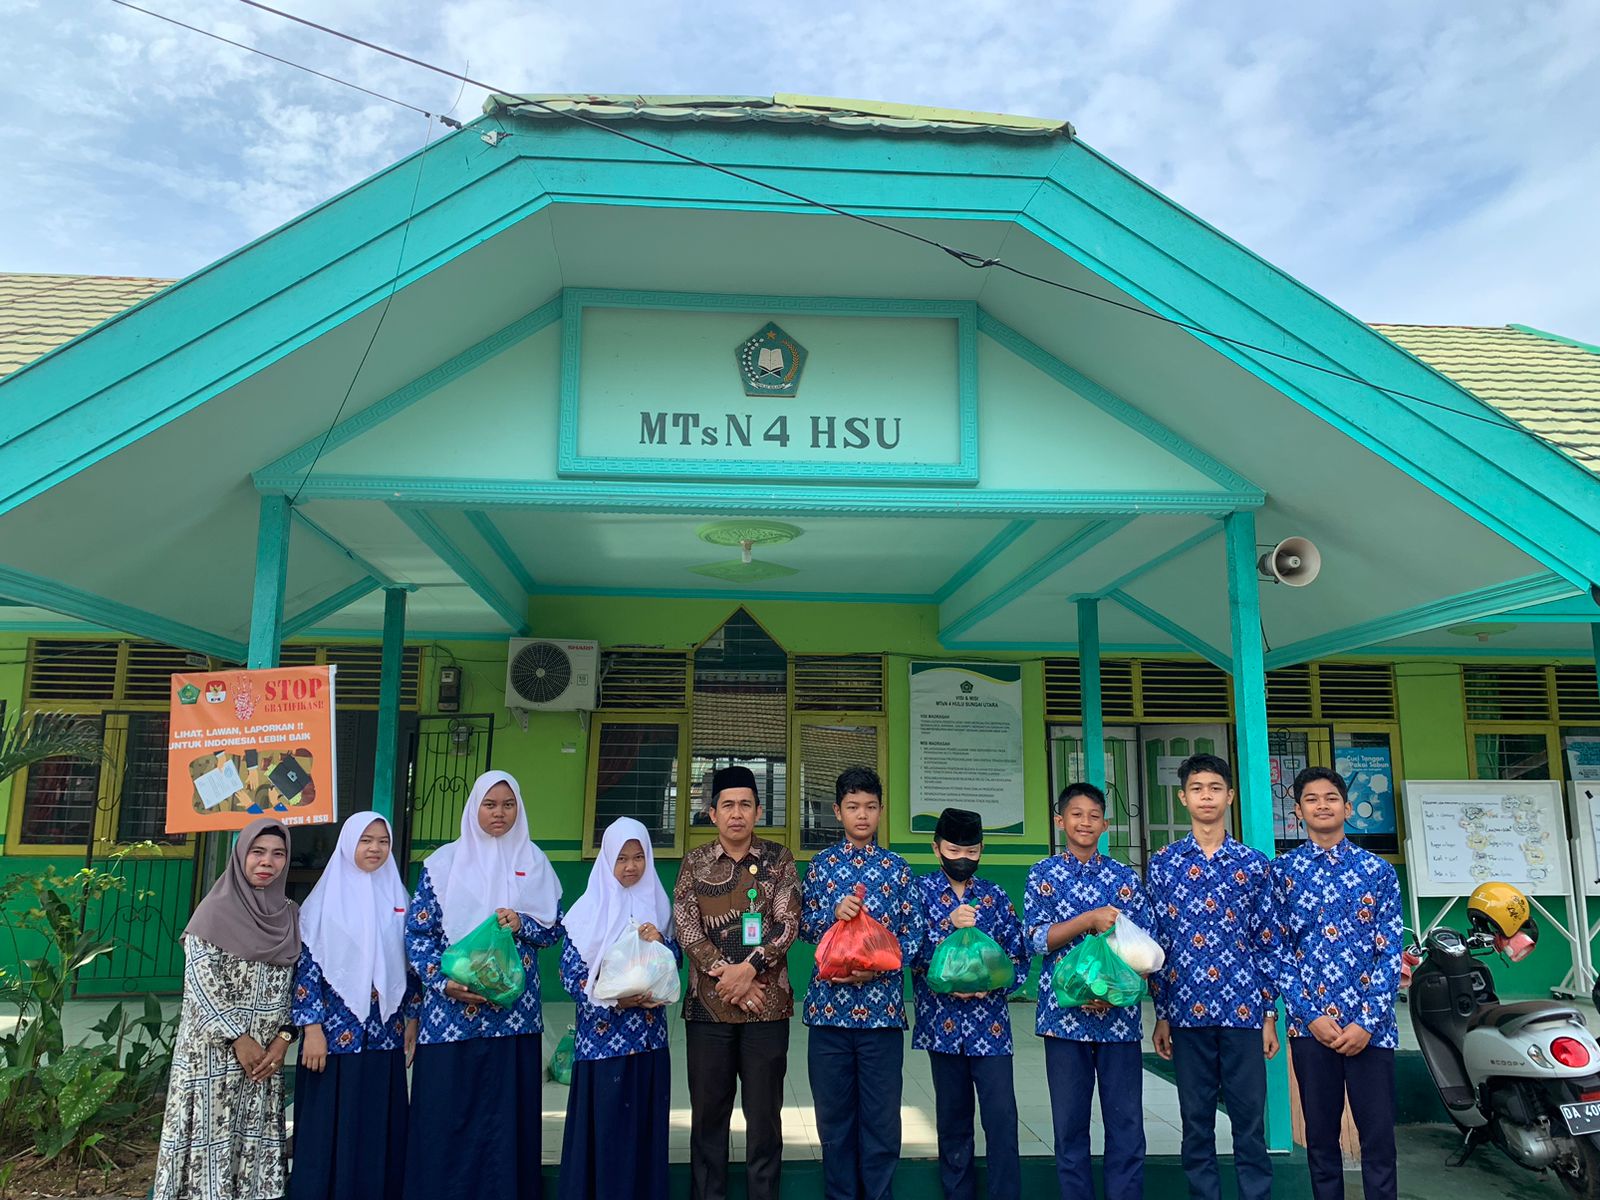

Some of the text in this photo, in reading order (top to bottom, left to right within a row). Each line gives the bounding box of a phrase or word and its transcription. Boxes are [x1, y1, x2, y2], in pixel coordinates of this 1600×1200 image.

[639, 411, 902, 449] MTsN 4 HSU
[265, 678, 322, 701] STOP
[244, 724, 295, 734] LAPORKAN
[204, 737, 256, 747] INDONESIA
[258, 734, 287, 743] LEBIH
[289, 732, 311, 741] BAIK
[1369, 760, 1390, 768] Sabun
[1563, 1106, 1581, 1119] DA
